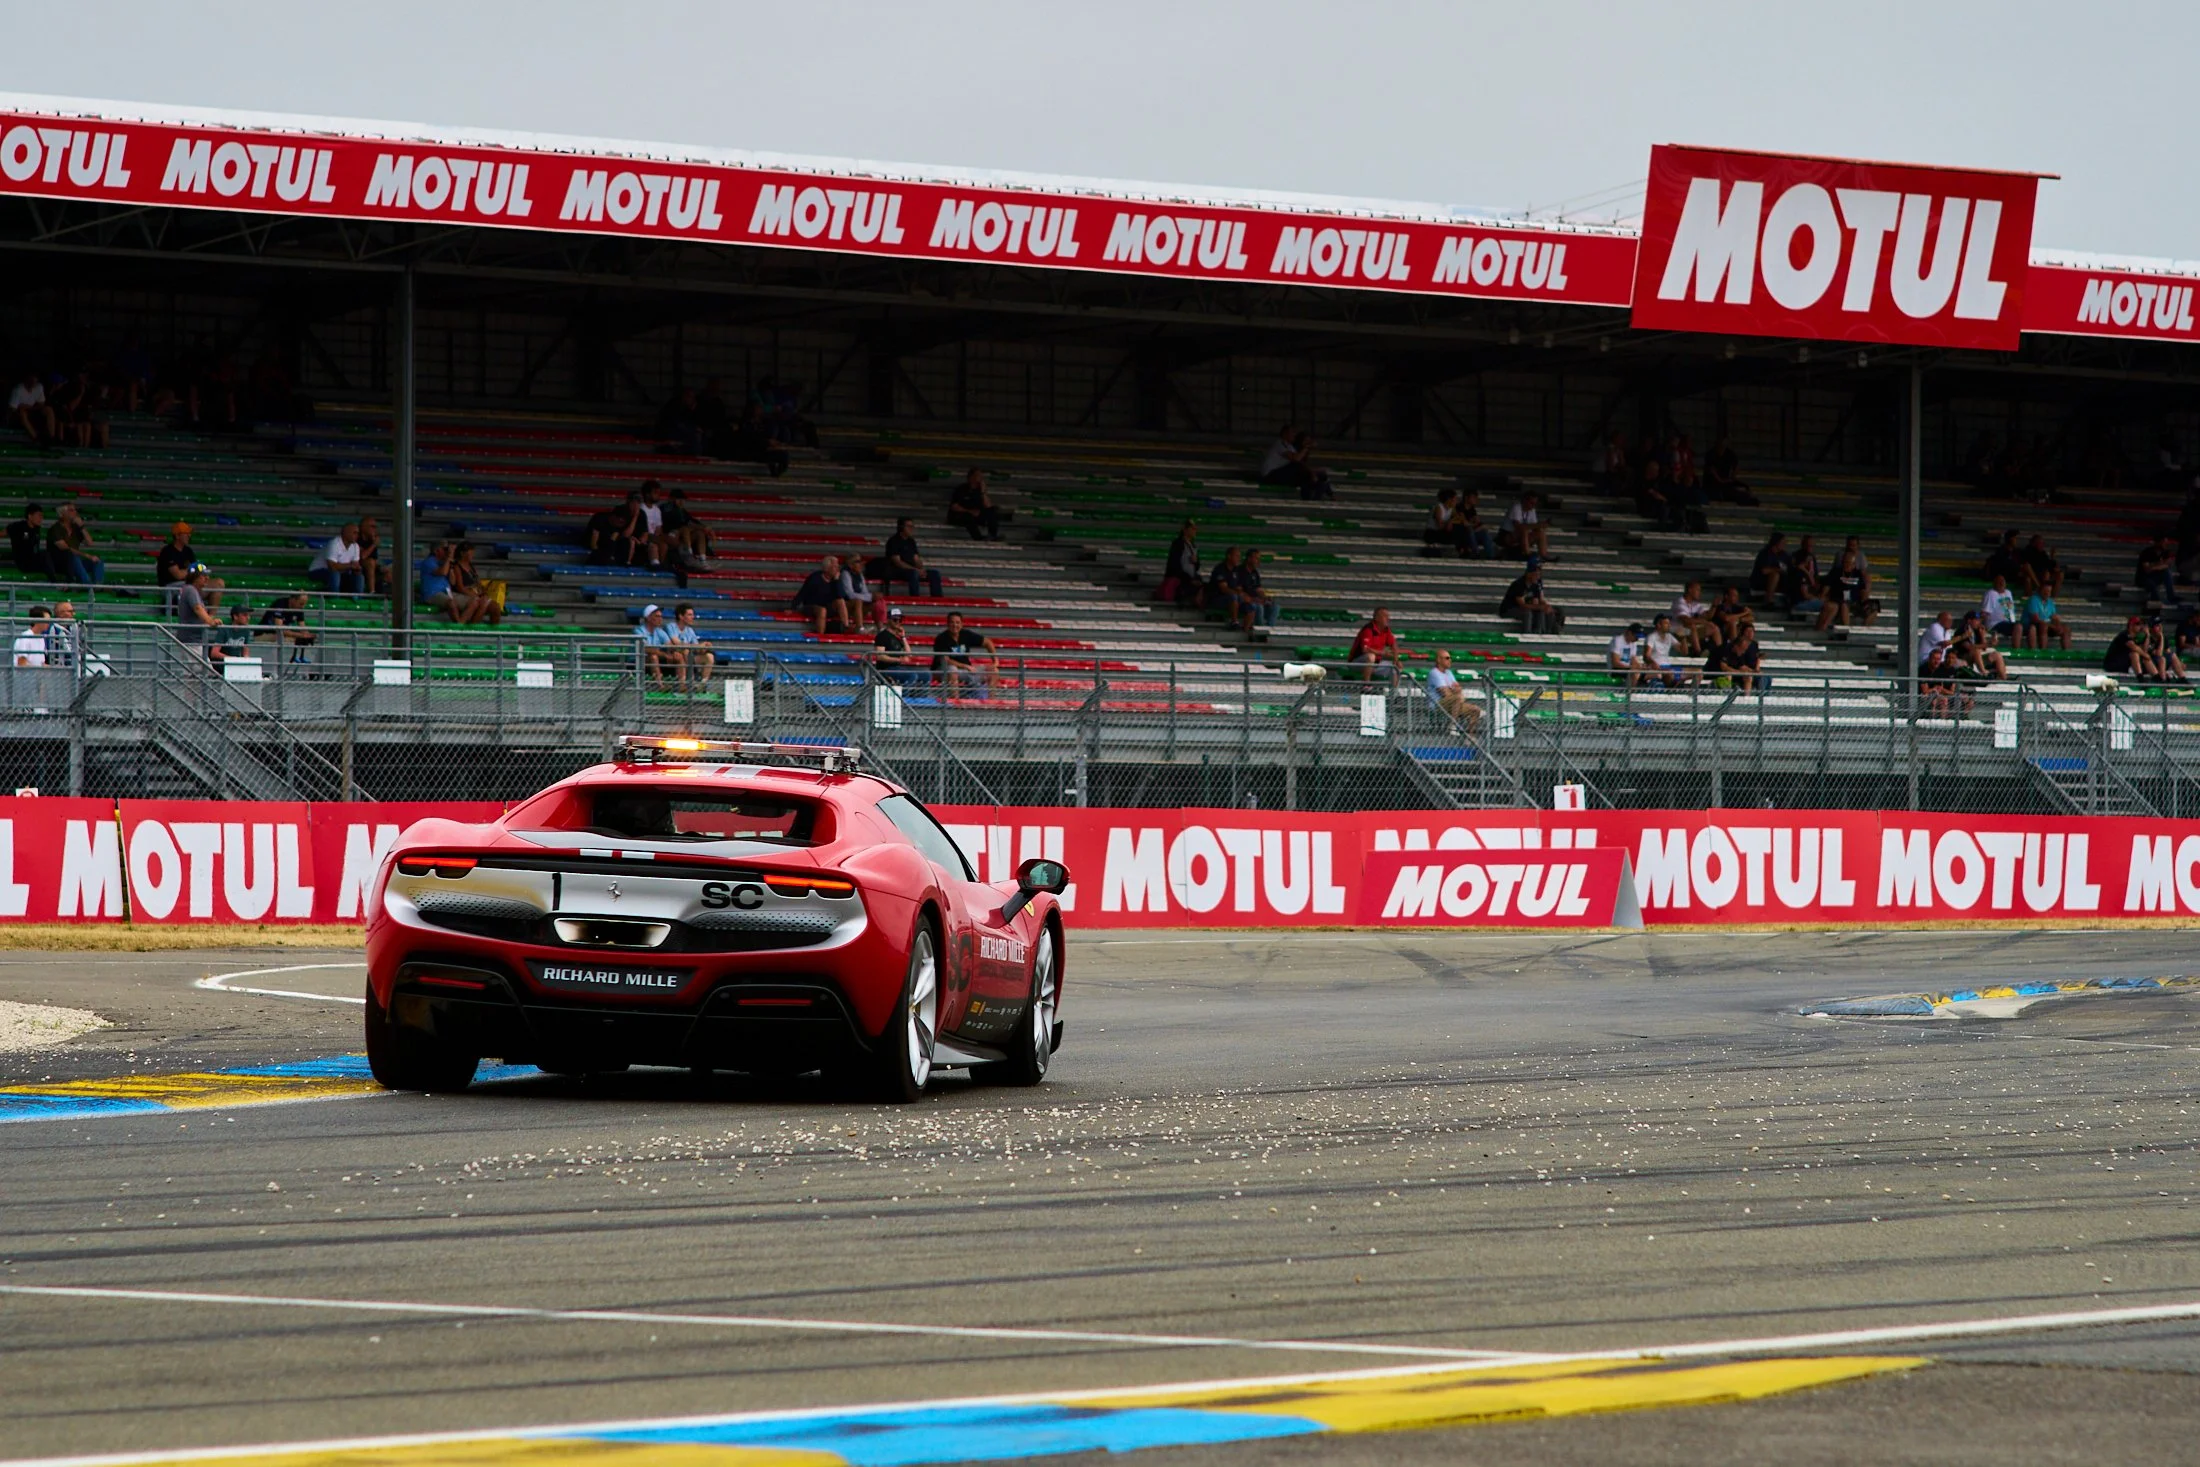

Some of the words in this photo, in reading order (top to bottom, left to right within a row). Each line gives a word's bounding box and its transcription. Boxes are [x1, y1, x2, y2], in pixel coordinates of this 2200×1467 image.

[0, 124, 131, 188] OTUL
[161, 138, 336, 203] MOTUL
[365, 154, 532, 216] MOTUL
[560, 169, 723, 231] MOTUL
[749, 184, 905, 244] MOTUL
[930, 198, 1079, 258] MOTUL
[1104, 213, 1248, 270] MOTUL
[1271, 226, 1410, 281] MOTUL
[1433, 236, 1567, 290] MOTUL
[1658, 177, 2007, 321] MOTUL
[2078, 279, 2194, 331] MOTUL
[58, 819, 314, 920] MOTUL
[701, 882, 764, 910] SC
[1101, 825, 1346, 915] MOTUL
[1635, 825, 1856, 910] MOTUL
[1877, 829, 2101, 912] MOTUL
[1382, 863, 1590, 918] MOTUL
[980, 936, 1008, 961] RICHARD
[543, 967, 620, 984] RICHARD
[625, 973, 677, 988] MILLE
